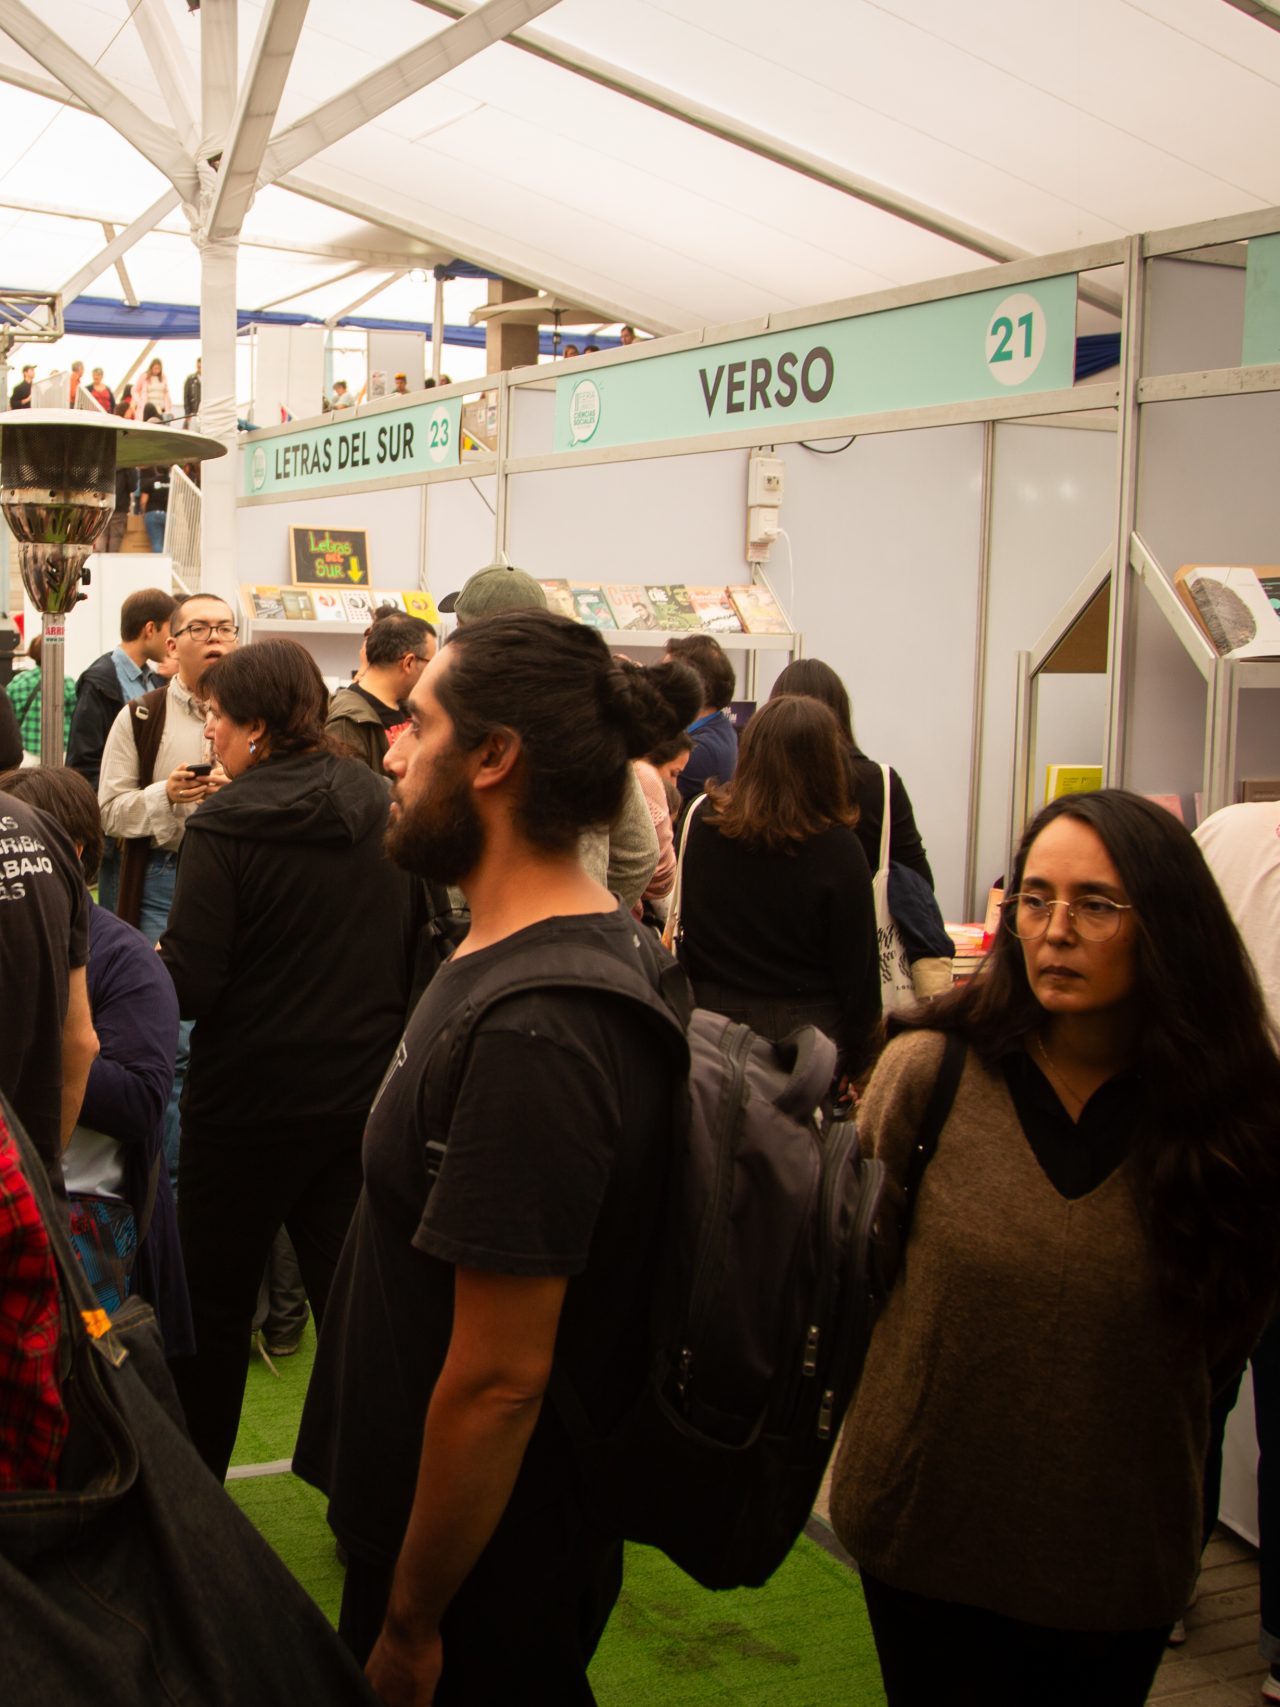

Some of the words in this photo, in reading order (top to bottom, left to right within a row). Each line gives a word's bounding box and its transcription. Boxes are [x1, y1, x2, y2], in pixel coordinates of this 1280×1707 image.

[988, 311, 1034, 364] 21
[698, 345, 835, 418] VERSO
[275, 437, 332, 480] LETRAS
[338, 431, 370, 470] DEL
[376, 422, 415, 464] SUR
[430, 418, 449, 448] 23
[309, 531, 352, 555] Letras
